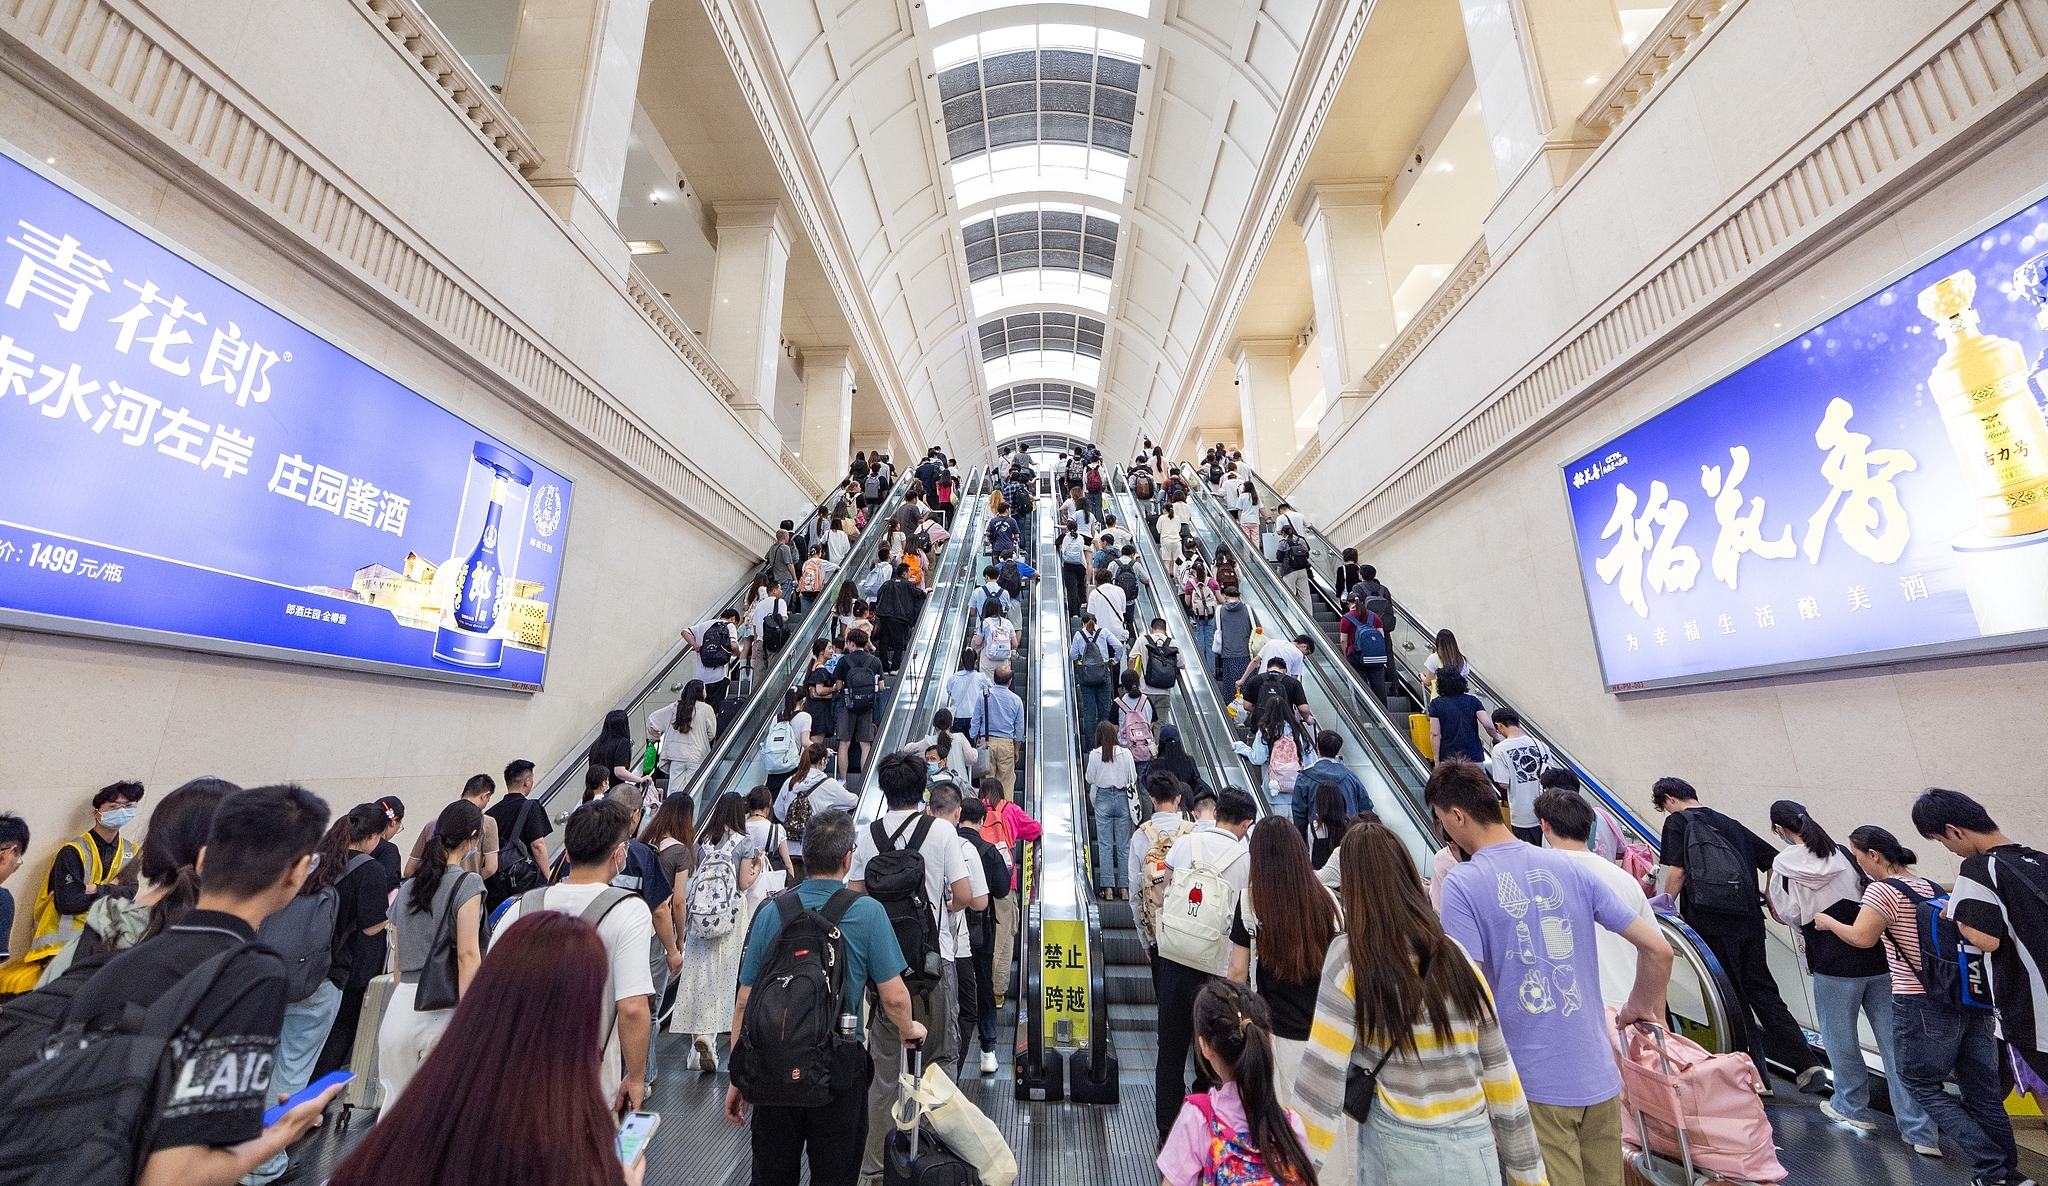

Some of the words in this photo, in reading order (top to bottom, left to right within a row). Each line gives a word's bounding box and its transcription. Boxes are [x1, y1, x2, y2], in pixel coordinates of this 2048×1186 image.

[267, 453, 411, 538] 庄园酱酒
[1625, 572, 1929, 652] 为幸福生活酿美酒
[1044, 943, 1085, 970] 禁止
[1967, 960, 1983, 995] FILA
[1045, 985, 1086, 1013] 跨越
